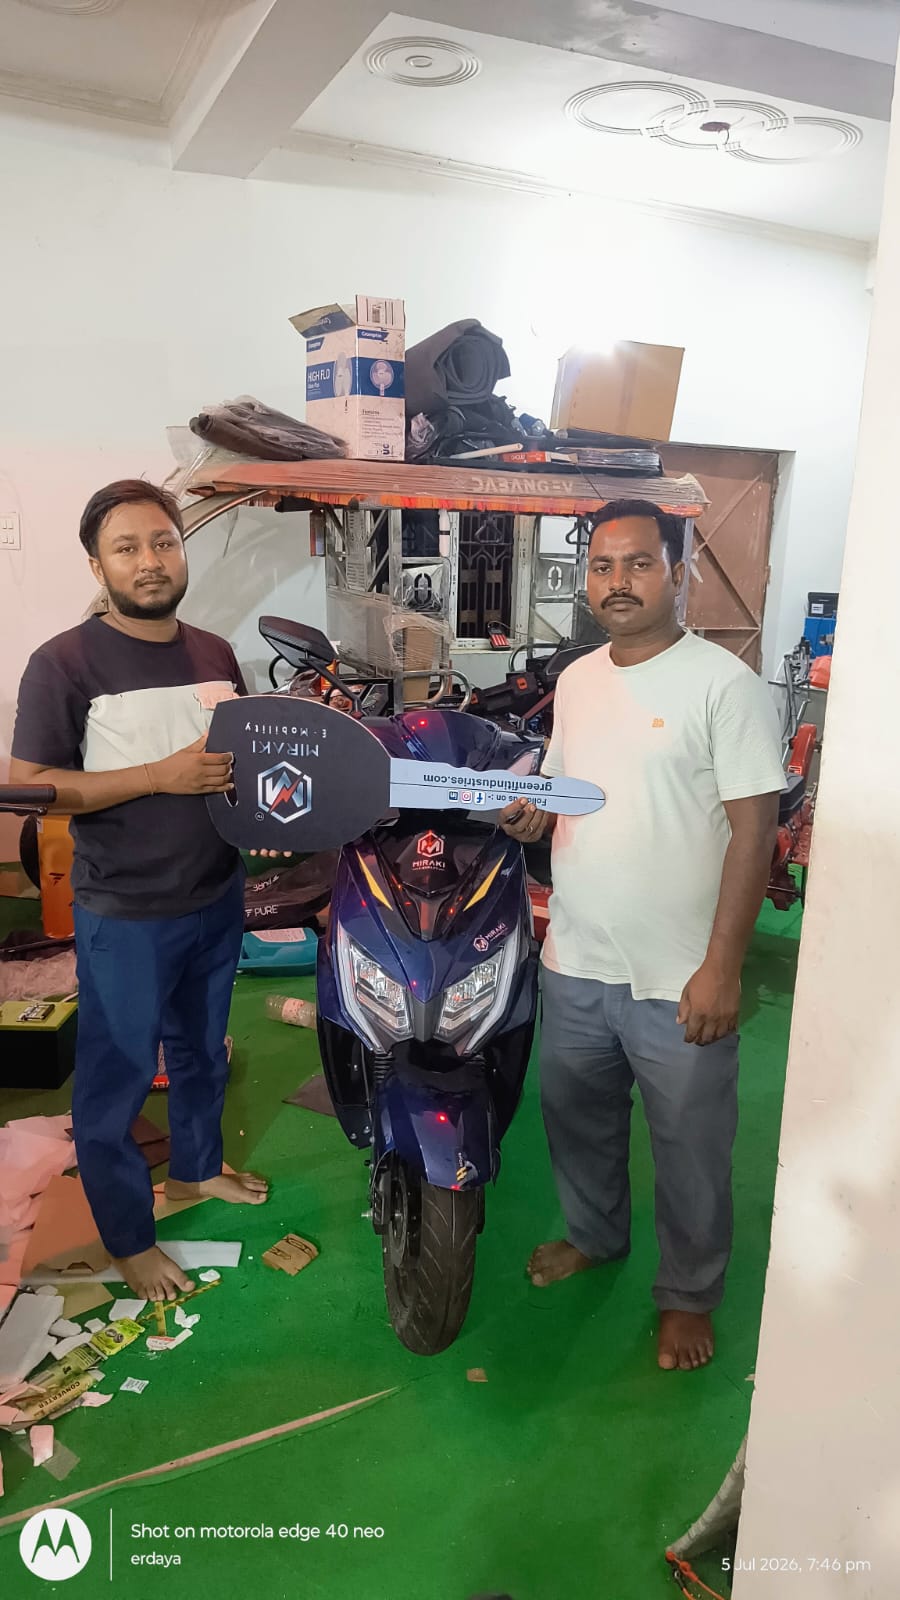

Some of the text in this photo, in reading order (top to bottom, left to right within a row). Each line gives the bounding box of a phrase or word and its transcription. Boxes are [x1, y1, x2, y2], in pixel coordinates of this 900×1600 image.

[307, 370, 319, 382] HIGH
[252, 740, 319, 757] MIRAKI
[423, 774, 553, 792] greenfitindustries.com
[496, 794, 507, 802] on
[412, 859, 446, 869] MIRAKI
[254, 904, 279, 917] PURE
[485, 922, 507, 940] MIRAKI
[39, 1381, 81, 1409] CONVERTER
